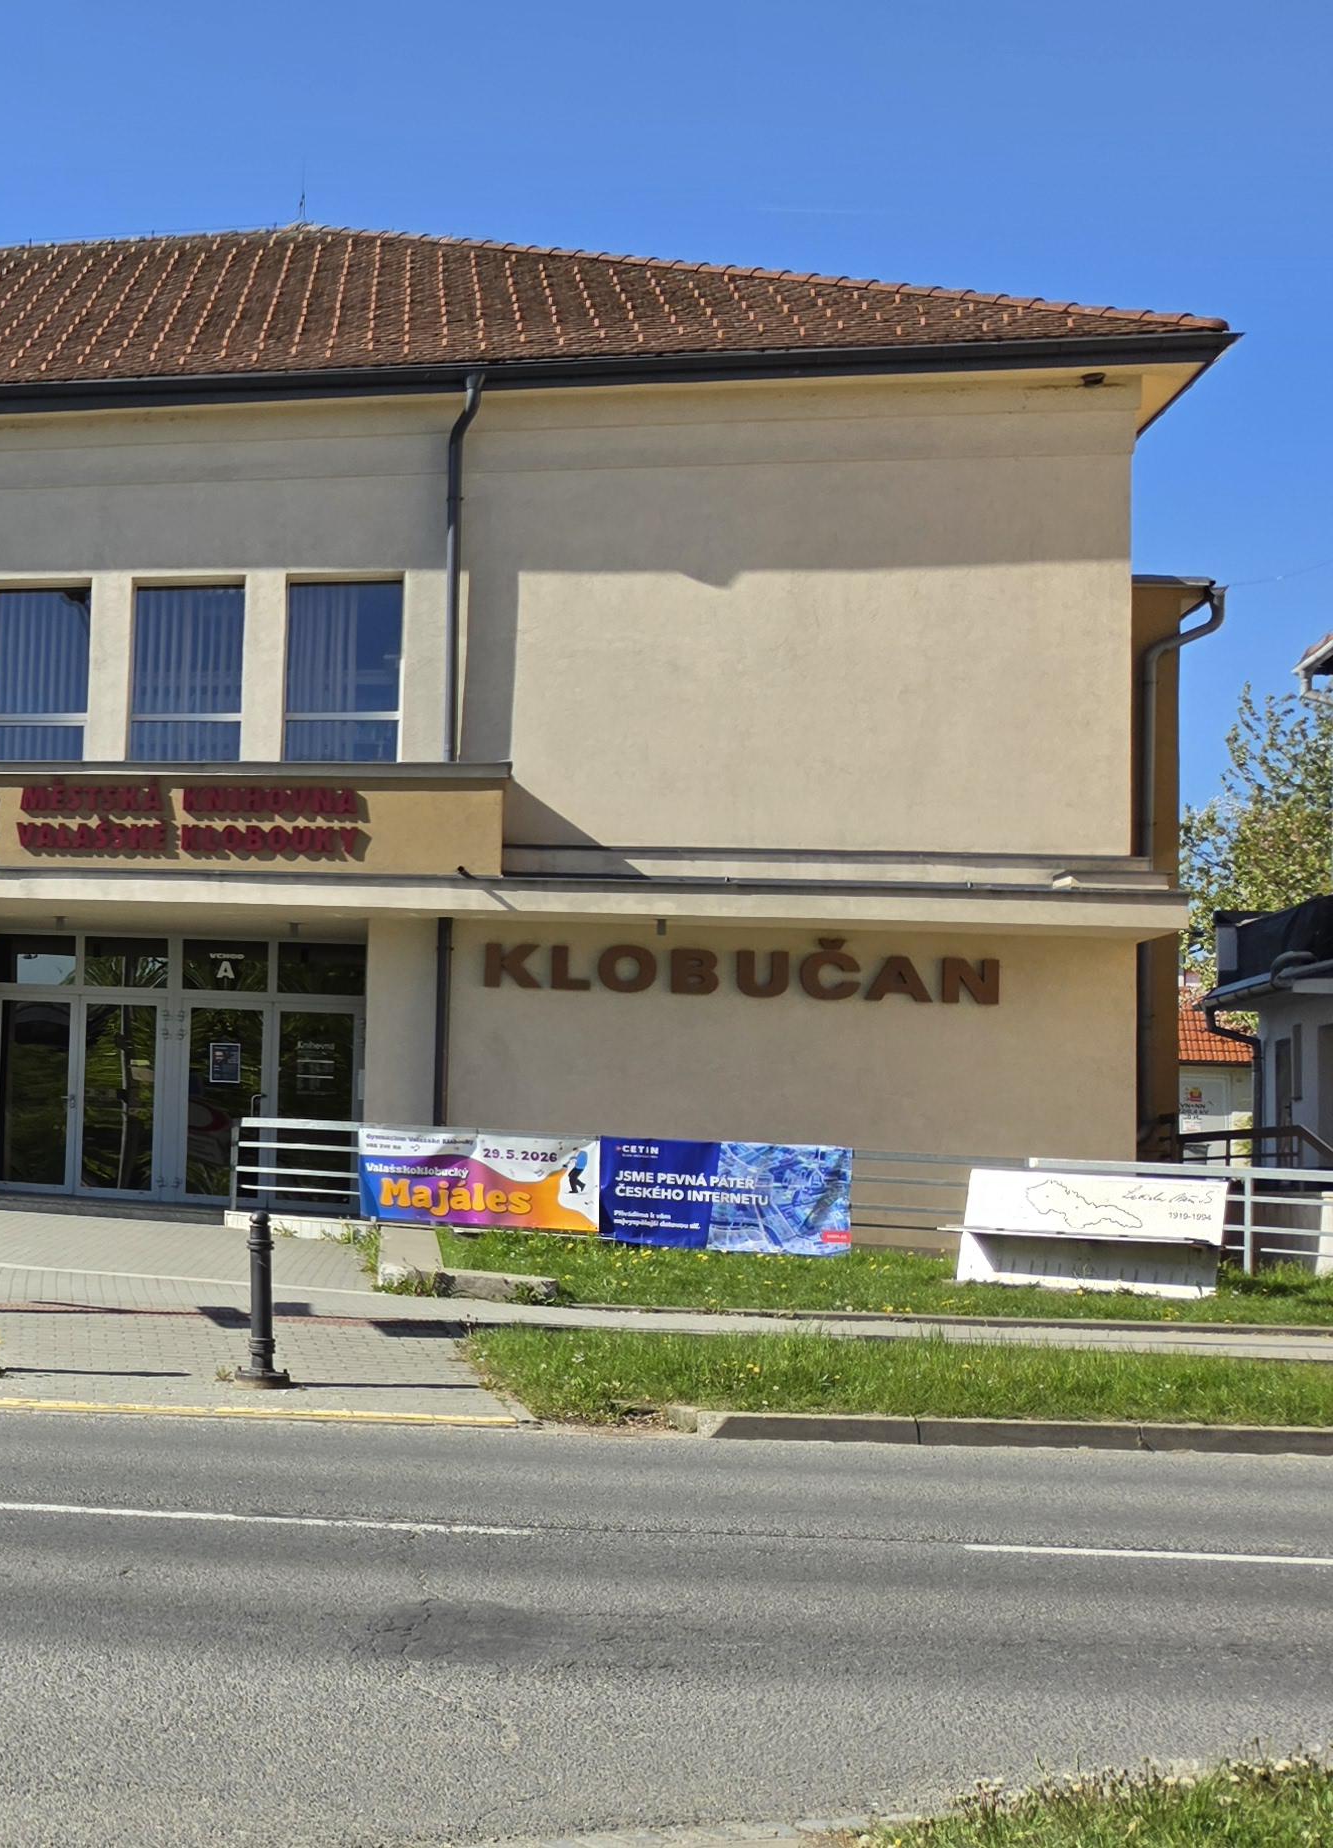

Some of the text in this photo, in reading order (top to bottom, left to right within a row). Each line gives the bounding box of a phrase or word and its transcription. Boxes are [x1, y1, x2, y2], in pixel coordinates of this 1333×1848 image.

[21, 777, 358, 814] MĚSTSKÁ KNIHOVNA
[16, 818, 358, 855] VALAŠSKÉ KLOBOUKY
[216, 961, 235, 978] A
[483, 936, 1000, 1005] KLOBUČAN
[622, 1144, 659, 1155] CETIN
[365, 1162, 469, 1180] Valašskoklobucký
[615, 1170, 756, 1190] JSME PEVNÁ PÁTEŘ
[379, 1177, 533, 1217] Majáles
[615, 1183, 769, 1206] ČESKÉHO INTERNETU
